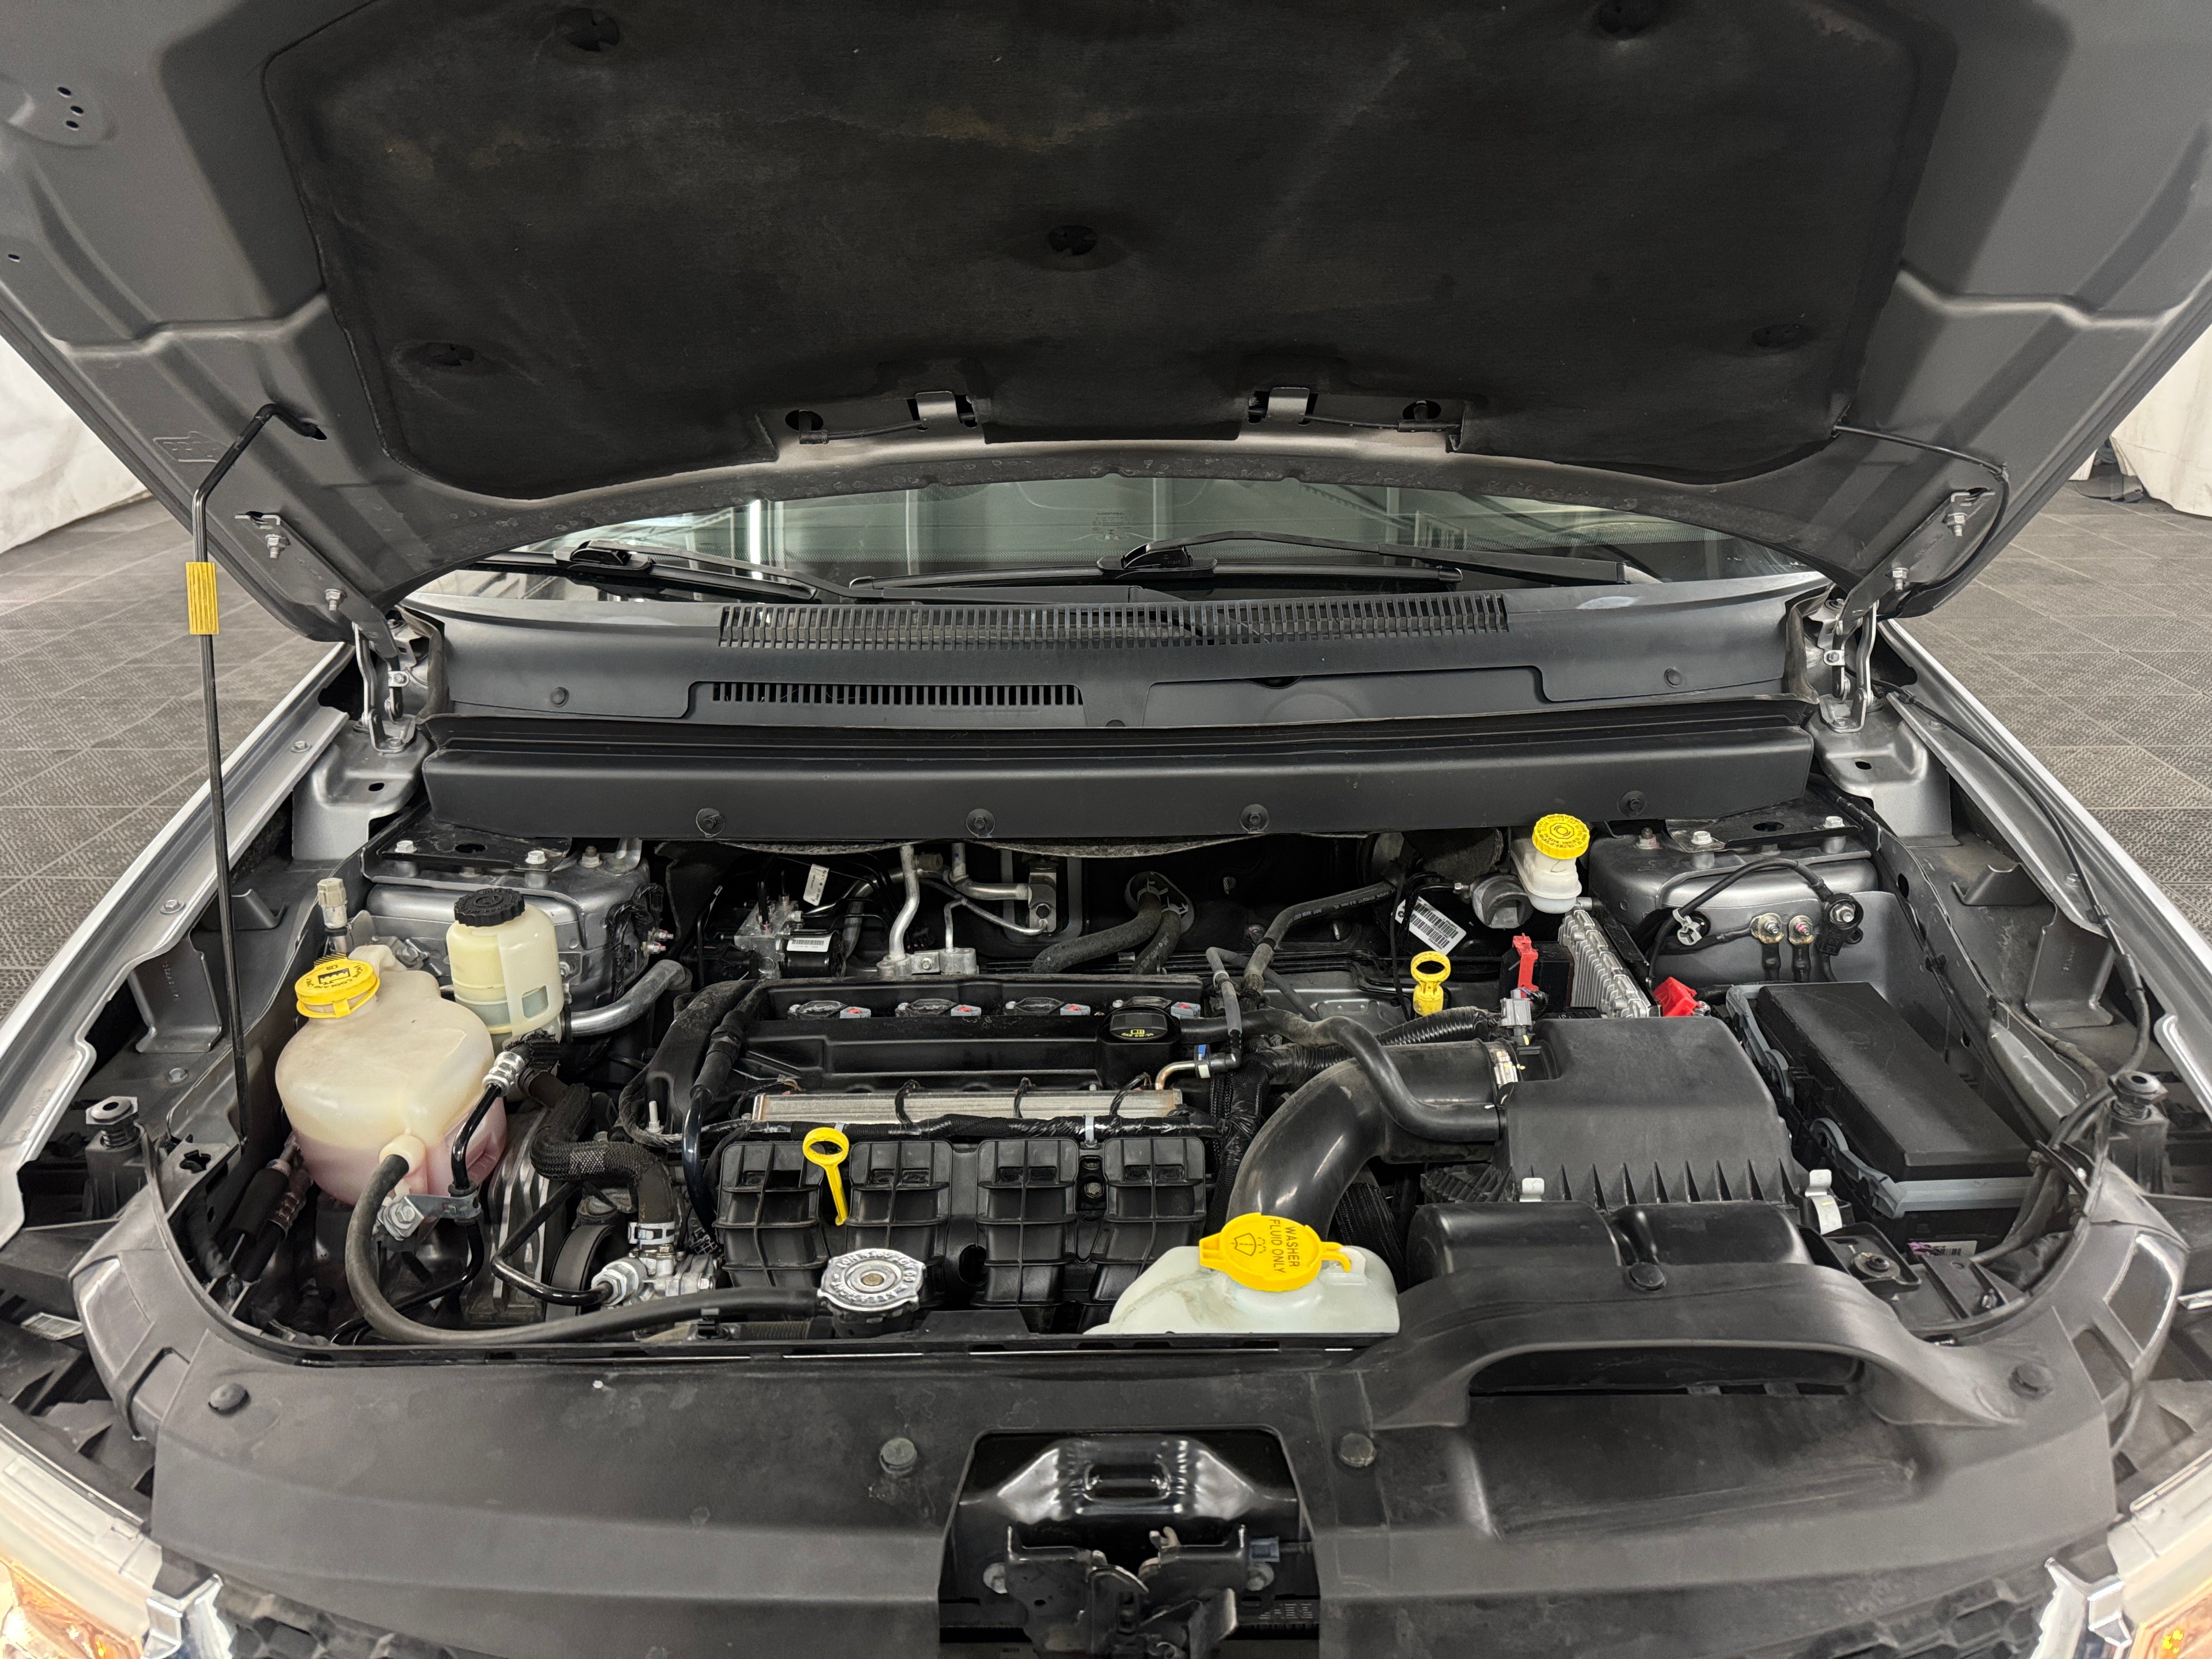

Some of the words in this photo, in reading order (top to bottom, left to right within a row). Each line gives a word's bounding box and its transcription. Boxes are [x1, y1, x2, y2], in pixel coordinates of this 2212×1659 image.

[1269, 1219, 1283, 1246] FLUID
[1285, 1226, 1300, 1267] WASHER
[1272, 1249, 1286, 1273] ONLY
